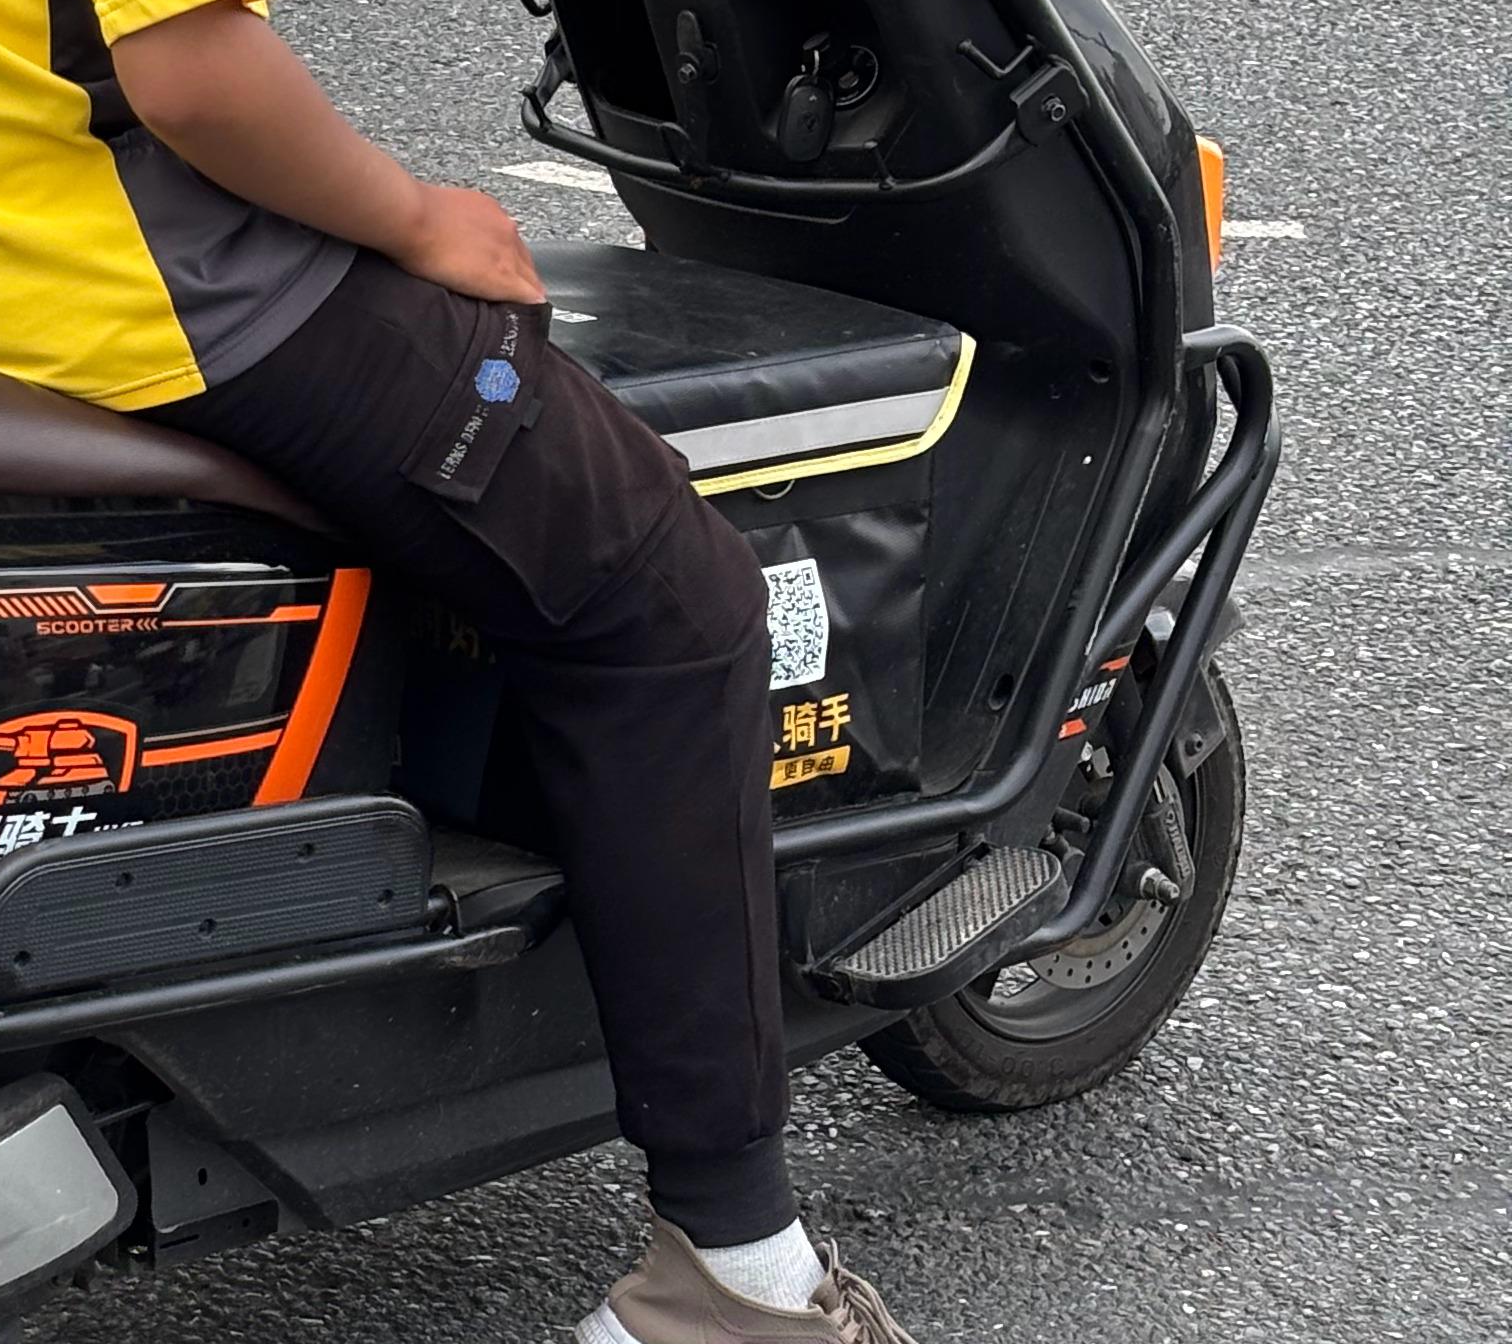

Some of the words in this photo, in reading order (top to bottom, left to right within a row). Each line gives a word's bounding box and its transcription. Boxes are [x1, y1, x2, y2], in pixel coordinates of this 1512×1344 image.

[36, 618, 134, 635] SCOOTER
[784, 755, 835, 780] 更自由
